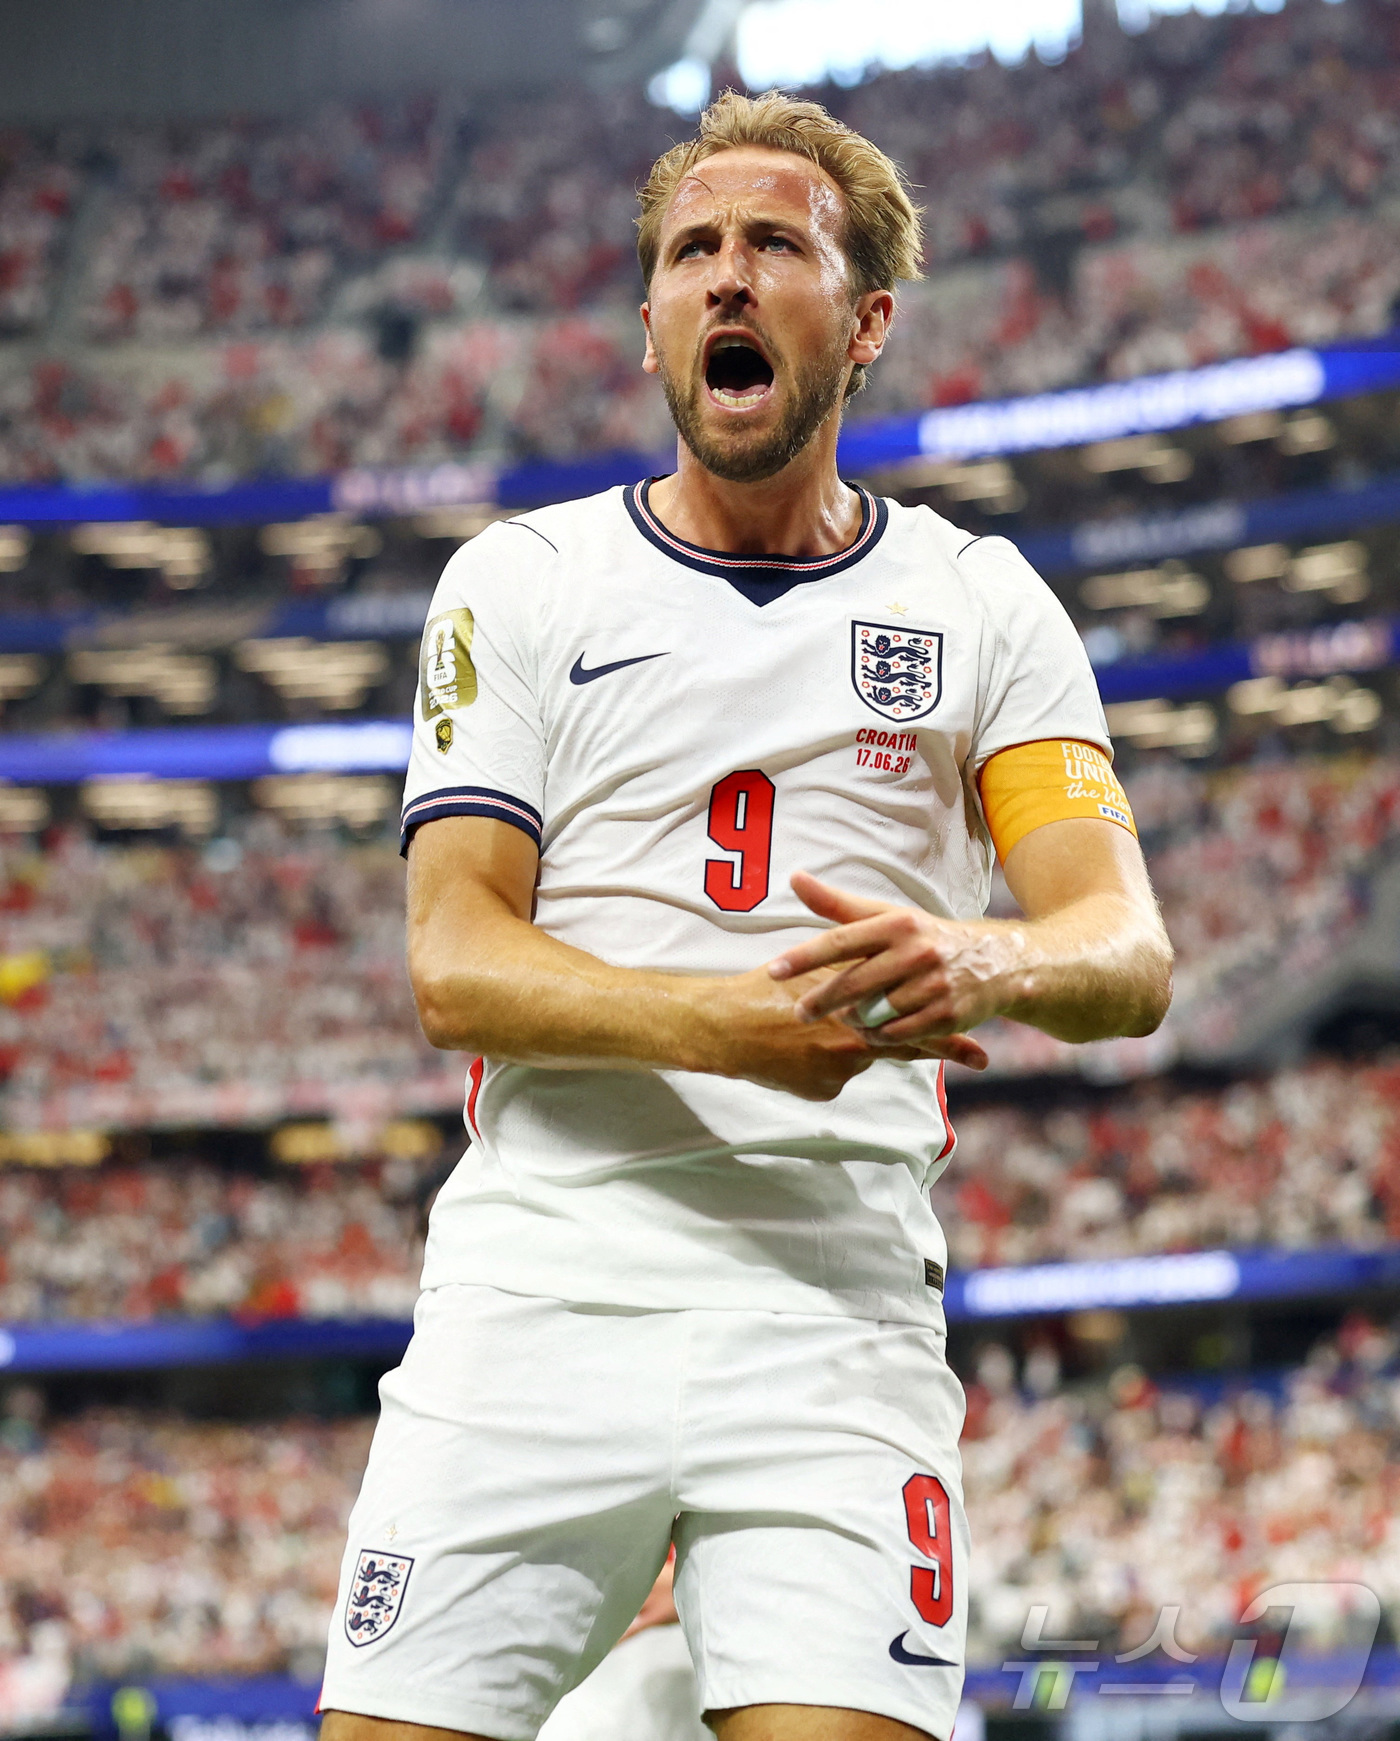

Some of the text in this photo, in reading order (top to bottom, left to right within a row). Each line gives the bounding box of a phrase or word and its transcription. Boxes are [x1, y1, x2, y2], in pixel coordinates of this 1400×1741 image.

[433, 672, 447, 681] FIFA
[445, 685, 457, 693] CUP
[856, 728, 917, 751] CROATIA
[856, 748, 910, 773] 17.06.26
[1063, 781, 1100, 799] the
[1102, 807, 1128, 824] FIFA
[704, 769, 776, 912] 9
[902, 1473, 953, 1628] 9
